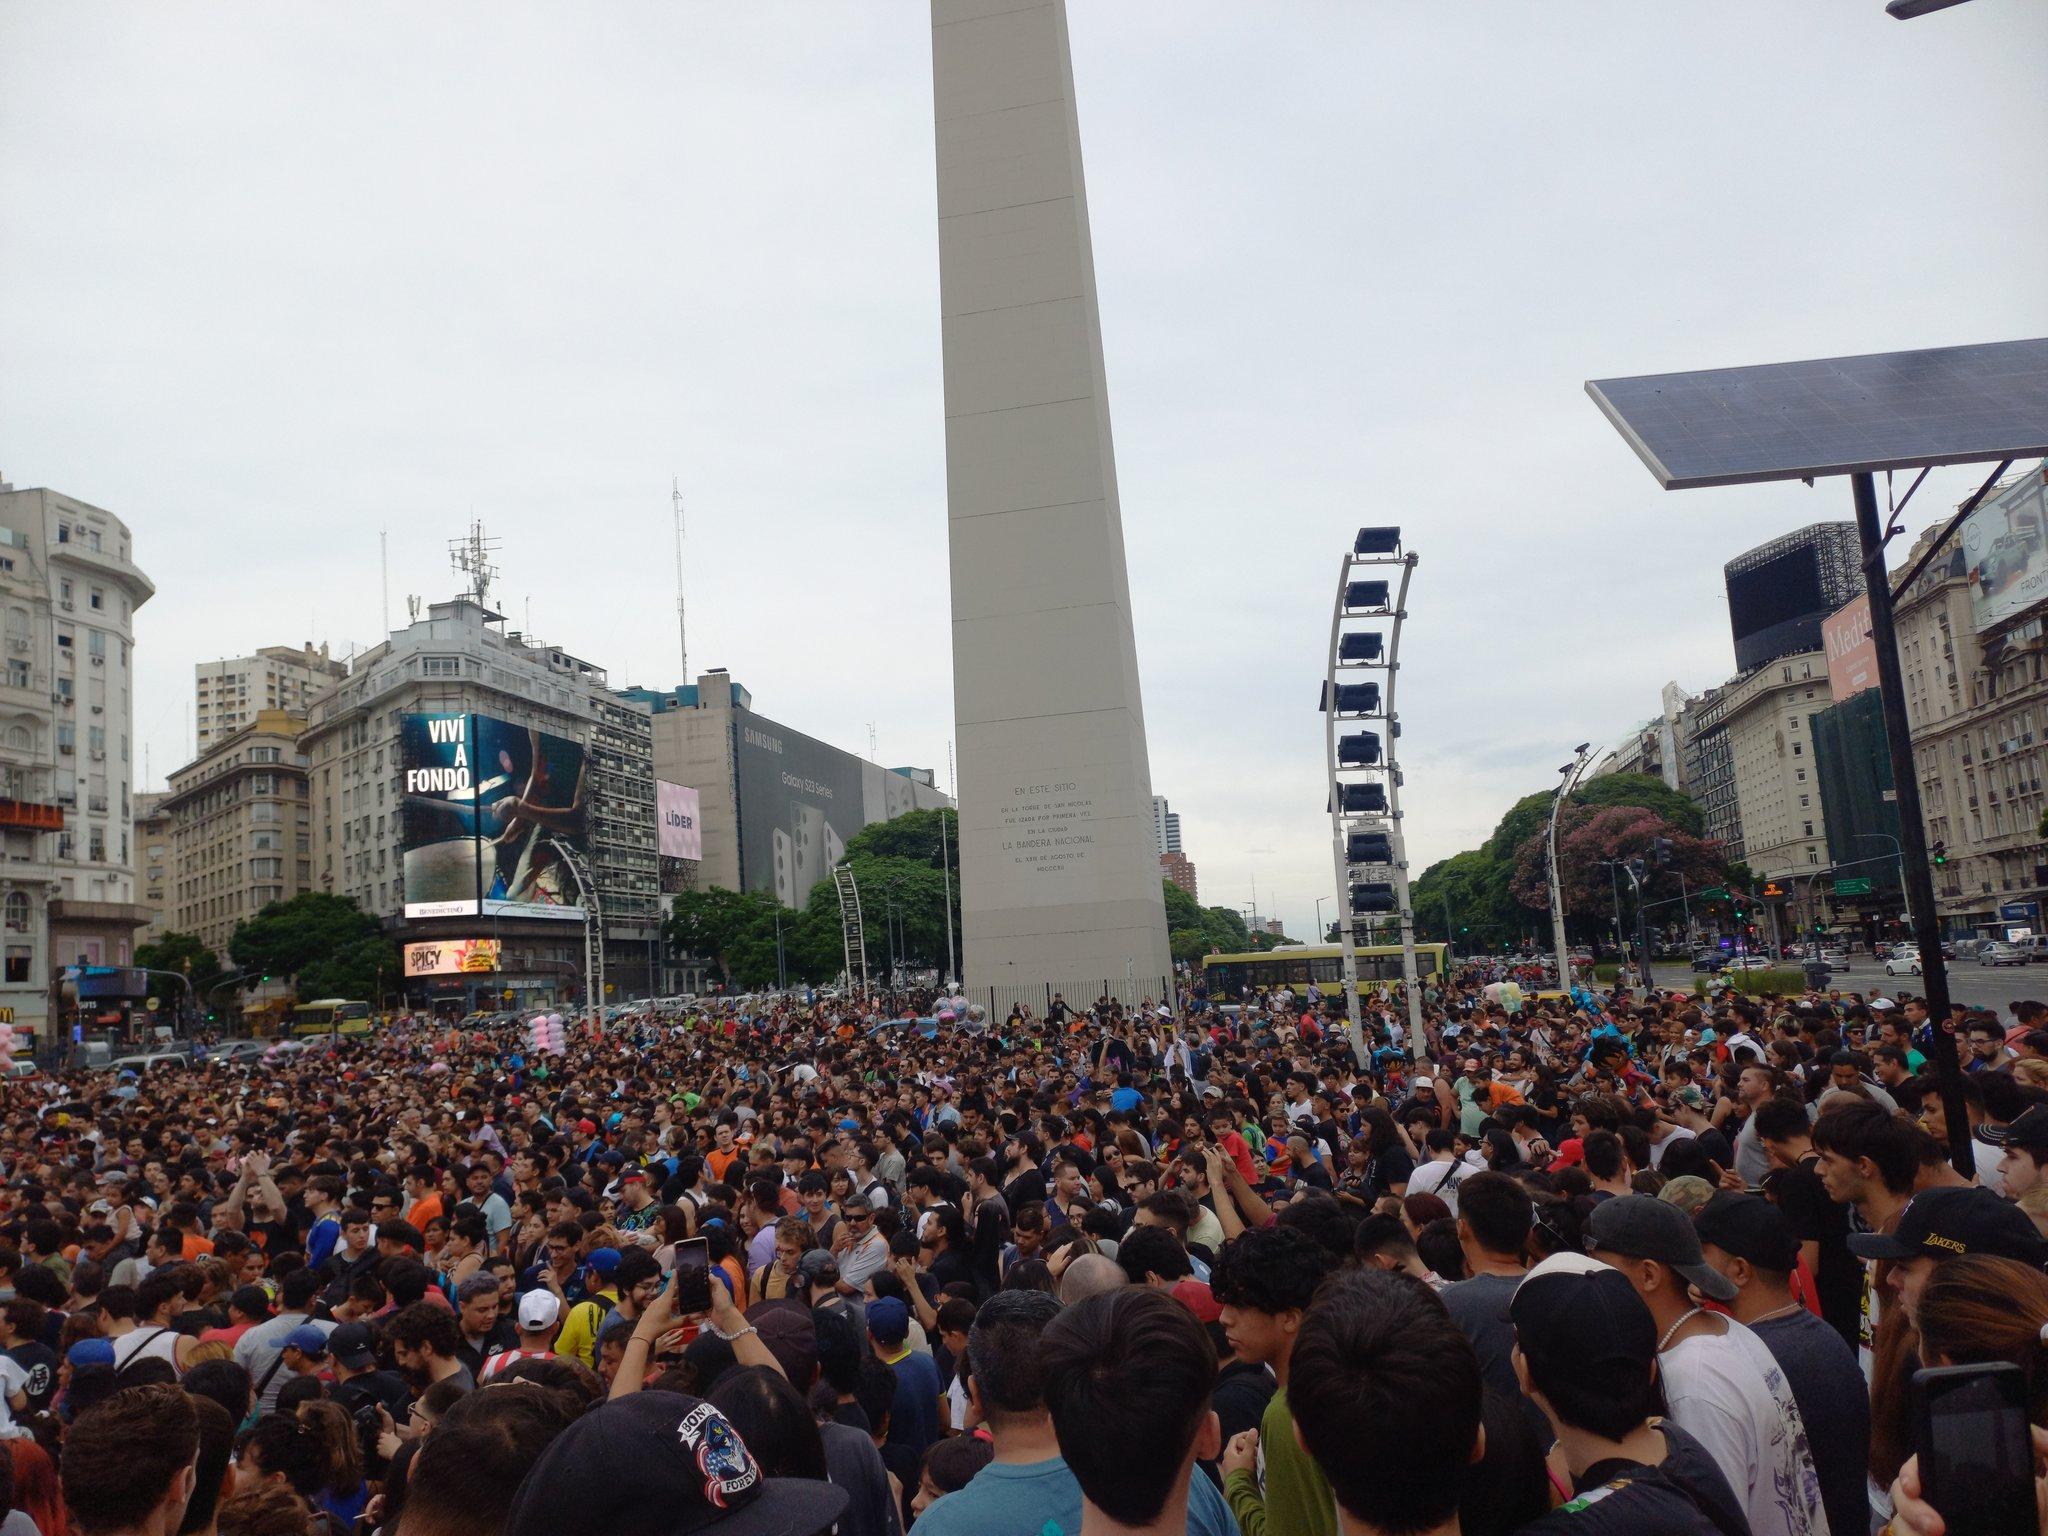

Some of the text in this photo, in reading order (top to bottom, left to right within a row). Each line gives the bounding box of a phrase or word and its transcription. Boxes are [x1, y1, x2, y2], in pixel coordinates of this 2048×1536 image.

[1828, 605, 1873, 662] Medif
[428, 713, 466, 743] VIVÍ
[744, 726, 783, 754] SAMSUNG
[454, 743, 467, 767] A
[407, 767, 470, 793] FONDO
[781, 771, 804, 794] Galaxy
[815, 782, 833, 799] Series
[1015, 782, 1077, 796] EN ESTE SITIO
[666, 810, 693, 829] LÍDER
[1002, 835, 1095, 850] LA BANDERA NACIONAL
[419, 906, 463, 916] BENEDICTINO
[411, 950, 441, 969] SPICY
[1923, 1232, 1966, 1254] LAKERS
